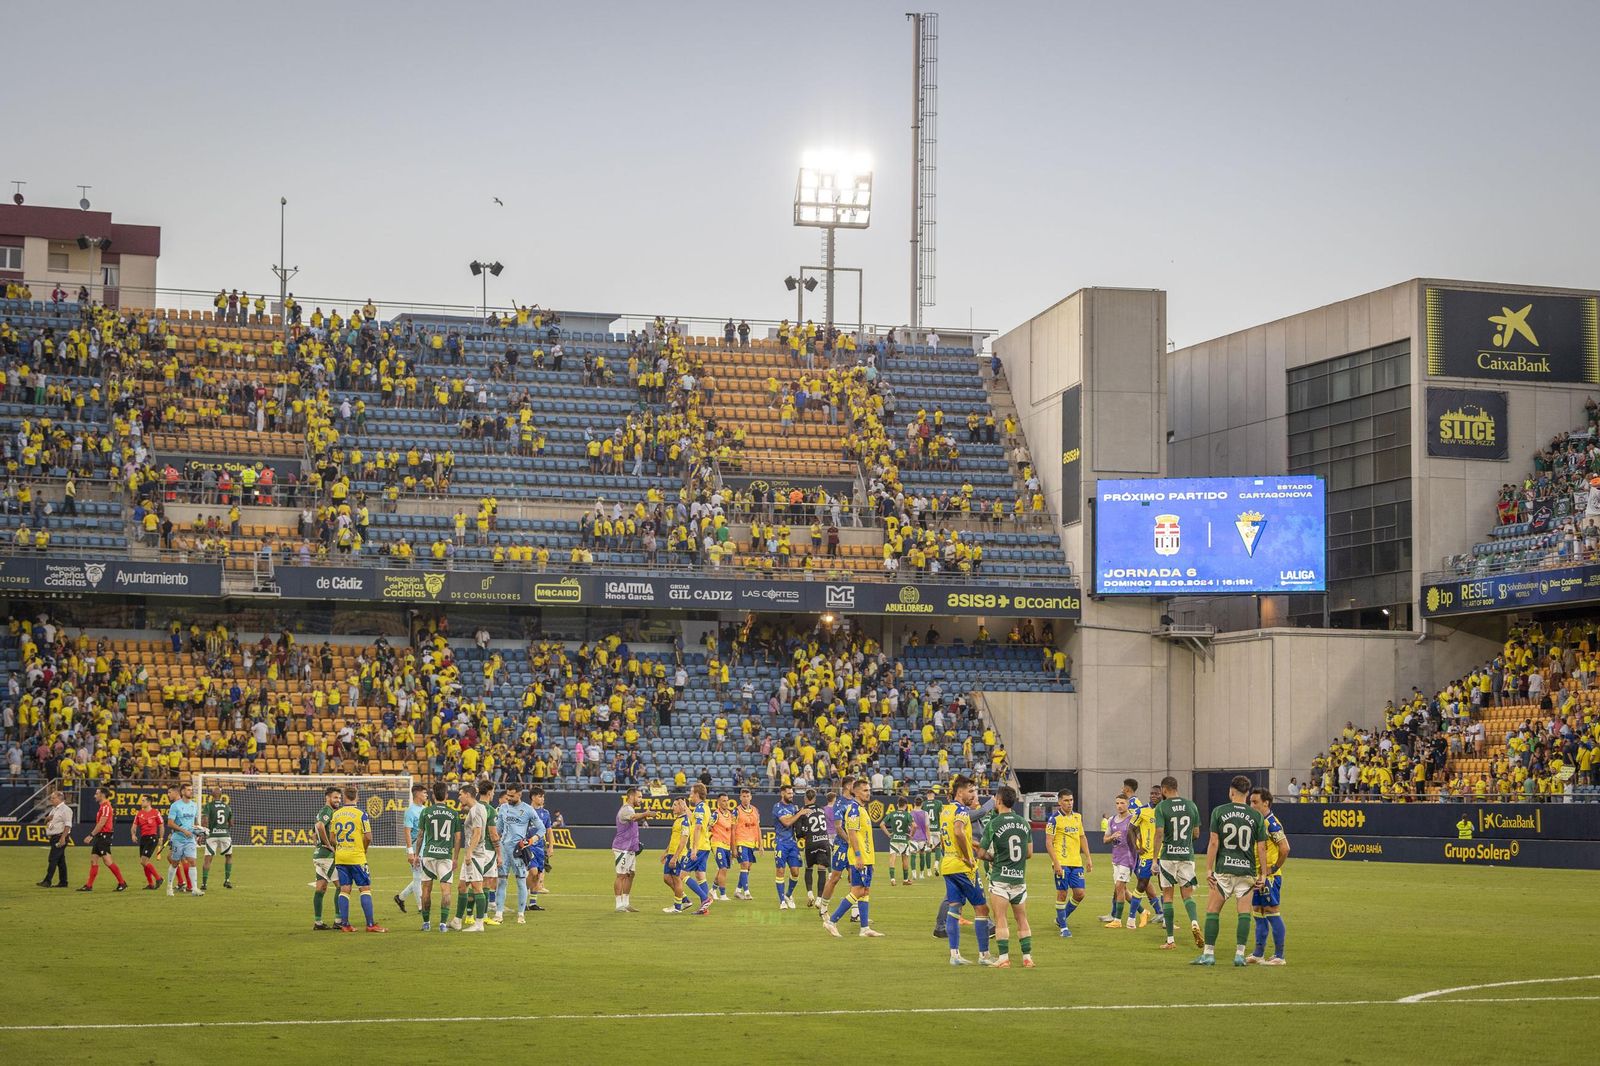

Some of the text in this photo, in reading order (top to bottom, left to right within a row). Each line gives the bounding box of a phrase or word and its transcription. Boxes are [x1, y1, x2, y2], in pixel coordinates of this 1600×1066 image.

[1478, 353, 1550, 372] CaixaBank
[1440, 420, 1495, 440] SLICE
[224, 462, 256, 472] Solea
[1104, 492, 1228, 501] PRÓXIMO PARTIDO
[116, 570, 188, 585] Ayuntamiento
[1104, 568, 1197, 577] JORNADA 6
[1280, 570, 1315, 580] LALIGA
[44, 577, 86, 586] Cadistas
[316, 576, 363, 590] de Cádiz
[384, 588, 426, 598] Cadistas
[464, 592, 520, 600] CONSULTORES
[628, 593, 654, 601] García
[669, 590, 733, 600] GIL CADIZ
[1461, 581, 1495, 600] RESET
[1027, 597, 1080, 609] coanda
[1441, 589, 1453, 607] bp
[885, 604, 933, 613] ABUELOBREAD
[217, 810, 225, 824] 5
[929, 809, 934, 820] 4
[1495, 814, 1535, 828] CaixaBank
[431, 819, 452, 841] 14
[809, 815, 826, 832] 25
[895, 820, 903, 832] 2
[1170, 816, 1190, 841] 12
[0, 826, 20, 840] XY
[335, 822, 355, 842] 22
[1223, 823, 1252, 851] 20
[1008, 835, 1022, 862] 6
[1348, 844, 1365, 853] GAMO
[1445, 843, 1510, 862] Grupo Solera
